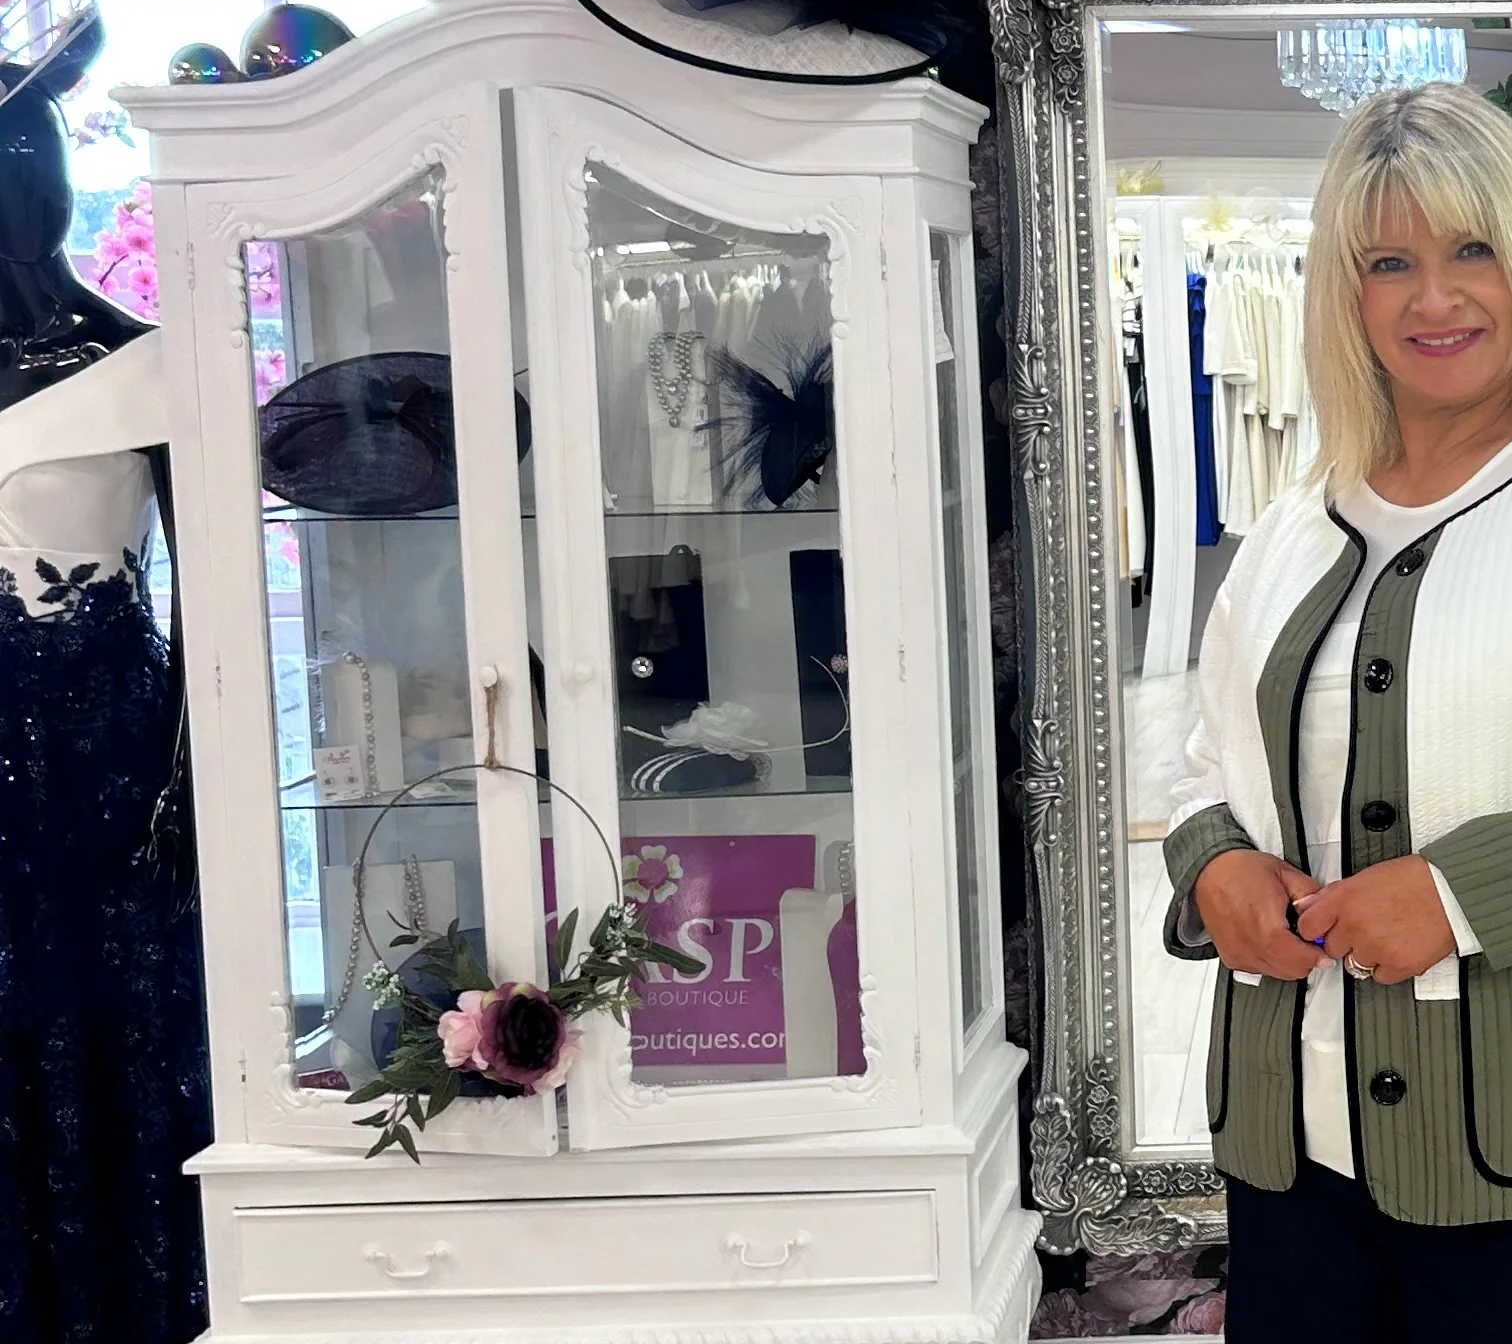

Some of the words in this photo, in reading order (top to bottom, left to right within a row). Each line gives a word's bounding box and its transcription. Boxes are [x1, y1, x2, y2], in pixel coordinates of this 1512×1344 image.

[645, 918, 774, 984] SP
[647, 990, 749, 1007] BOUTIQUE
[632, 1028, 785, 1056] outiques.co
